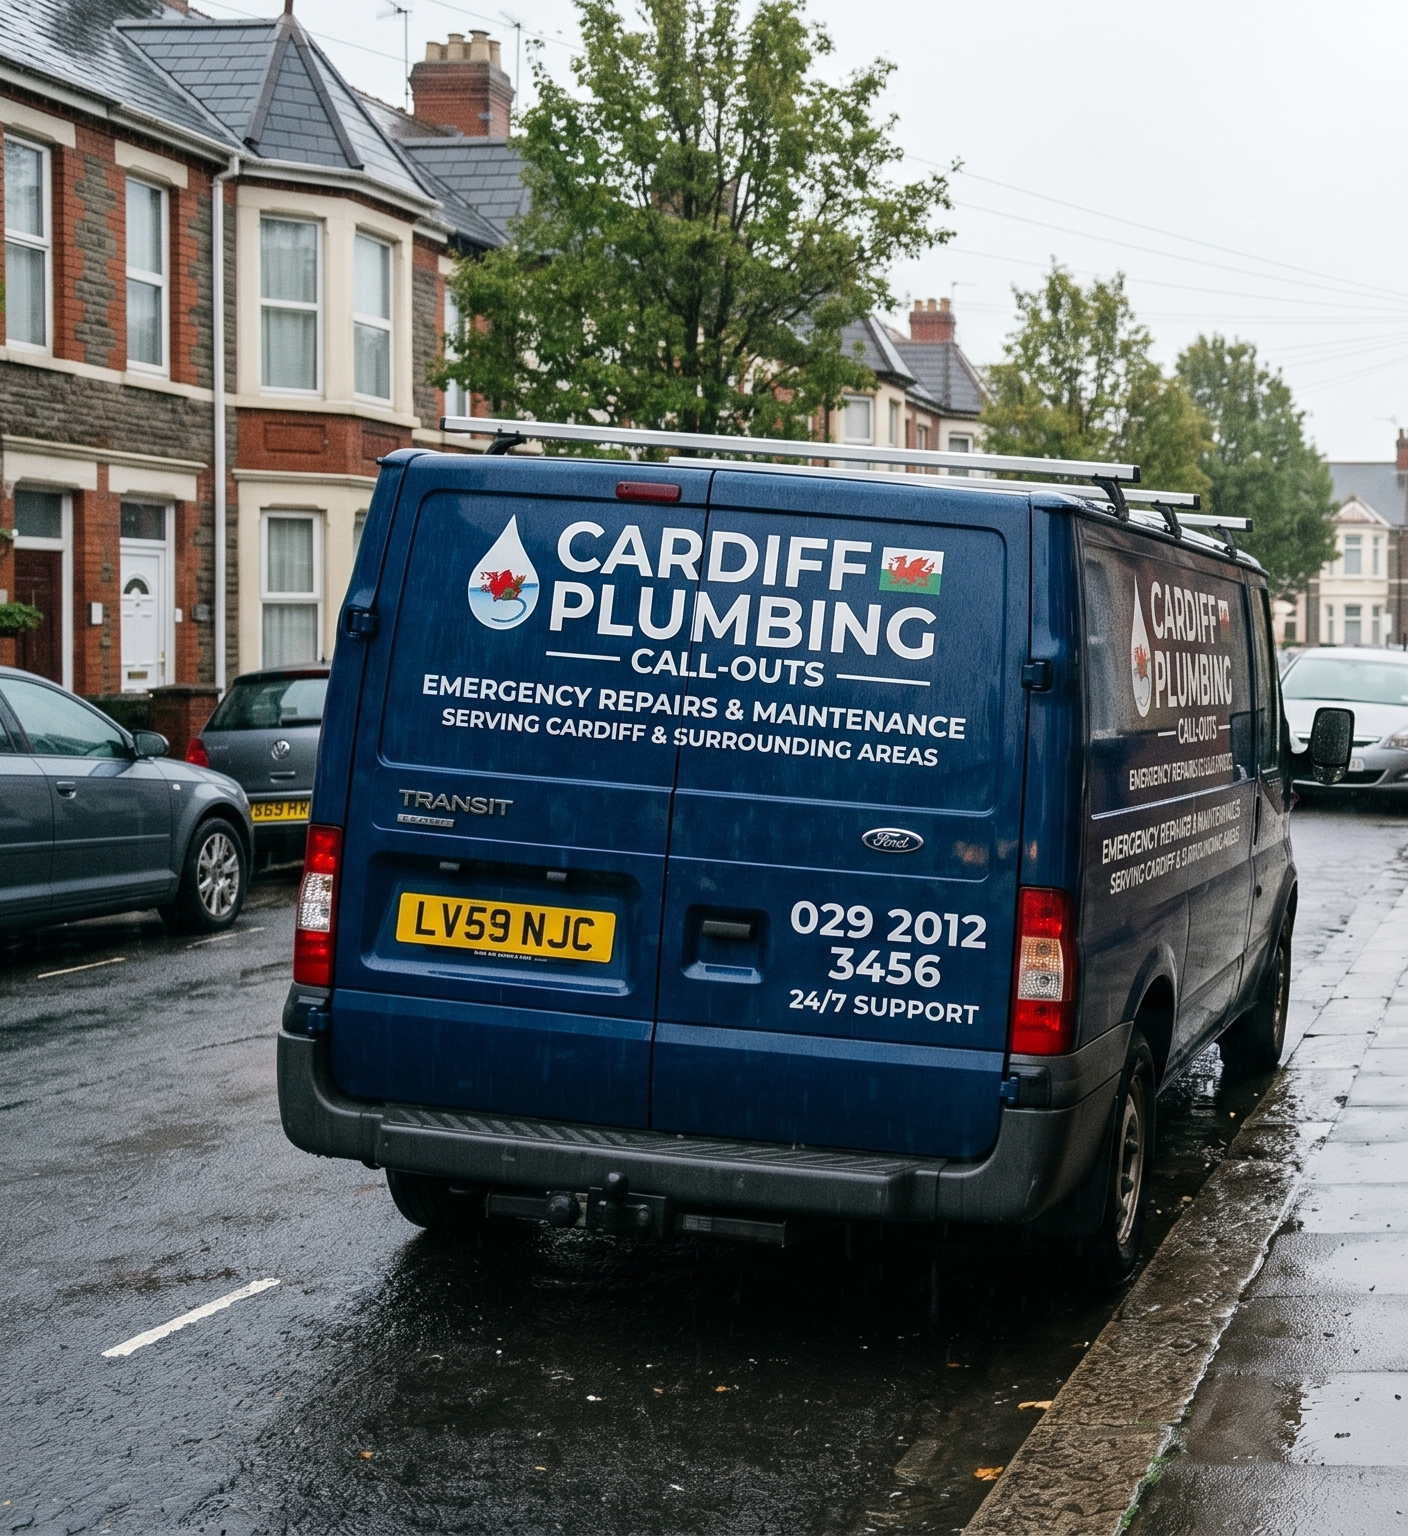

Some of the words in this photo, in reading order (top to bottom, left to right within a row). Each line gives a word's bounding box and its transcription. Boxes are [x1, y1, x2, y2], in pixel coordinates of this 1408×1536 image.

[556, 521, 873, 591] CARDIFF
[549, 581, 937, 659] PLUMBING
[1151, 581, 1217, 644] CARDIFF
[631, 648, 825, 687] CALL-OUTS
[1154, 650, 1233, 709] PLUMBING
[422, 674, 593, 708] EMERGENCY
[600, 688, 718, 718] REPAIRS
[725, 698, 744, 720] &
[752, 700, 966, 740] MAINTENANCE
[1178, 716, 1217, 744] CALL-OUTS
[441, 708, 540, 734] SERVING
[545, 717, 646, 743] CARDIFF
[651, 725, 668, 744] &
[673, 728, 852, 761] SURROUNDING
[857, 743, 938, 767] AREAS
[399, 789, 513, 816] TRANSIT
[1102, 825, 1160, 865] EMERGENCY
[414, 900, 511, 943] LV59
[521, 911, 595, 952] NJC
[790, 900, 874, 939] 029
[887, 908, 987, 949] 2012
[827, 946, 941, 988] 3456
[789, 989, 847, 1014] 24/7
[853, 995, 980, 1025] SUPPORT
